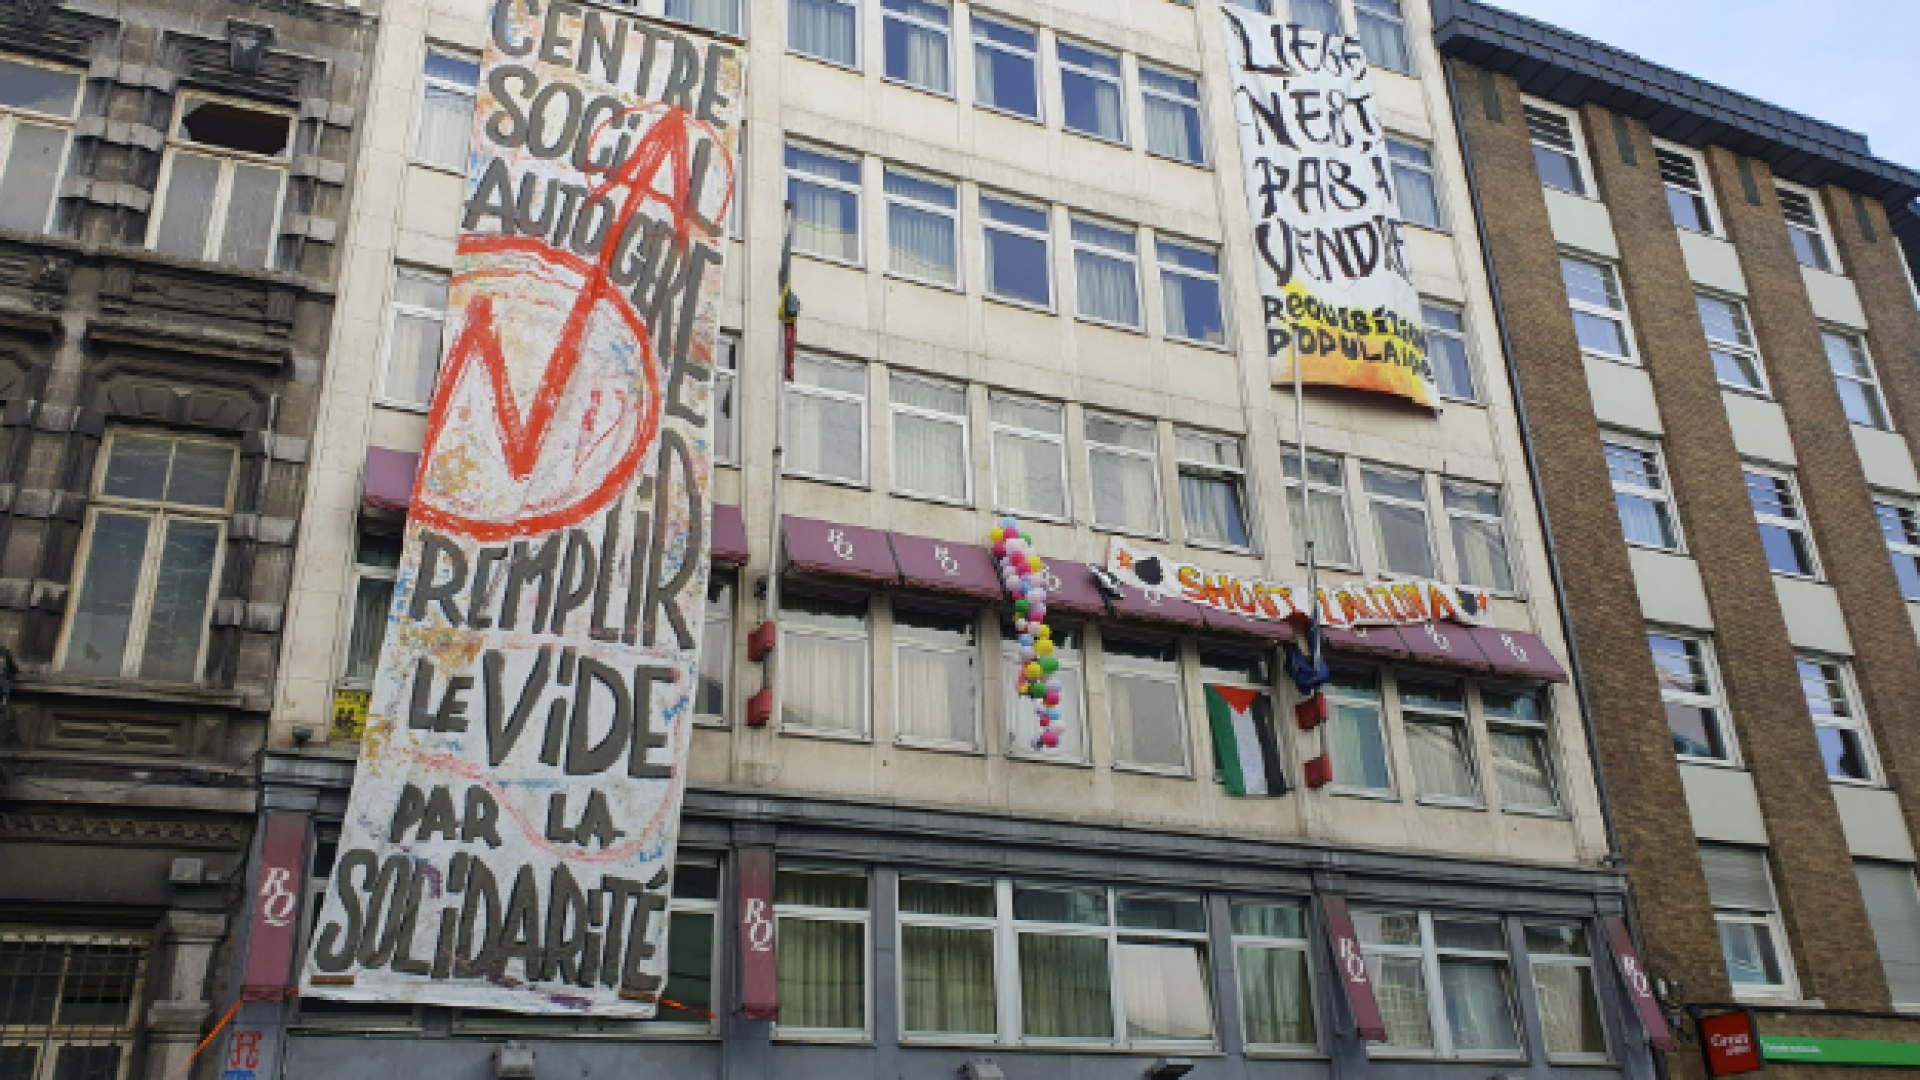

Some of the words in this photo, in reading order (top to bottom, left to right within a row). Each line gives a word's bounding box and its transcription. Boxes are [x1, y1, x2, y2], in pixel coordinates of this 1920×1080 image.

[491, 0, 734, 129] CENTRE
[409, 654, 474, 733] LE
[389, 783, 502, 849] PAR
[545, 787, 626, 850] LA
